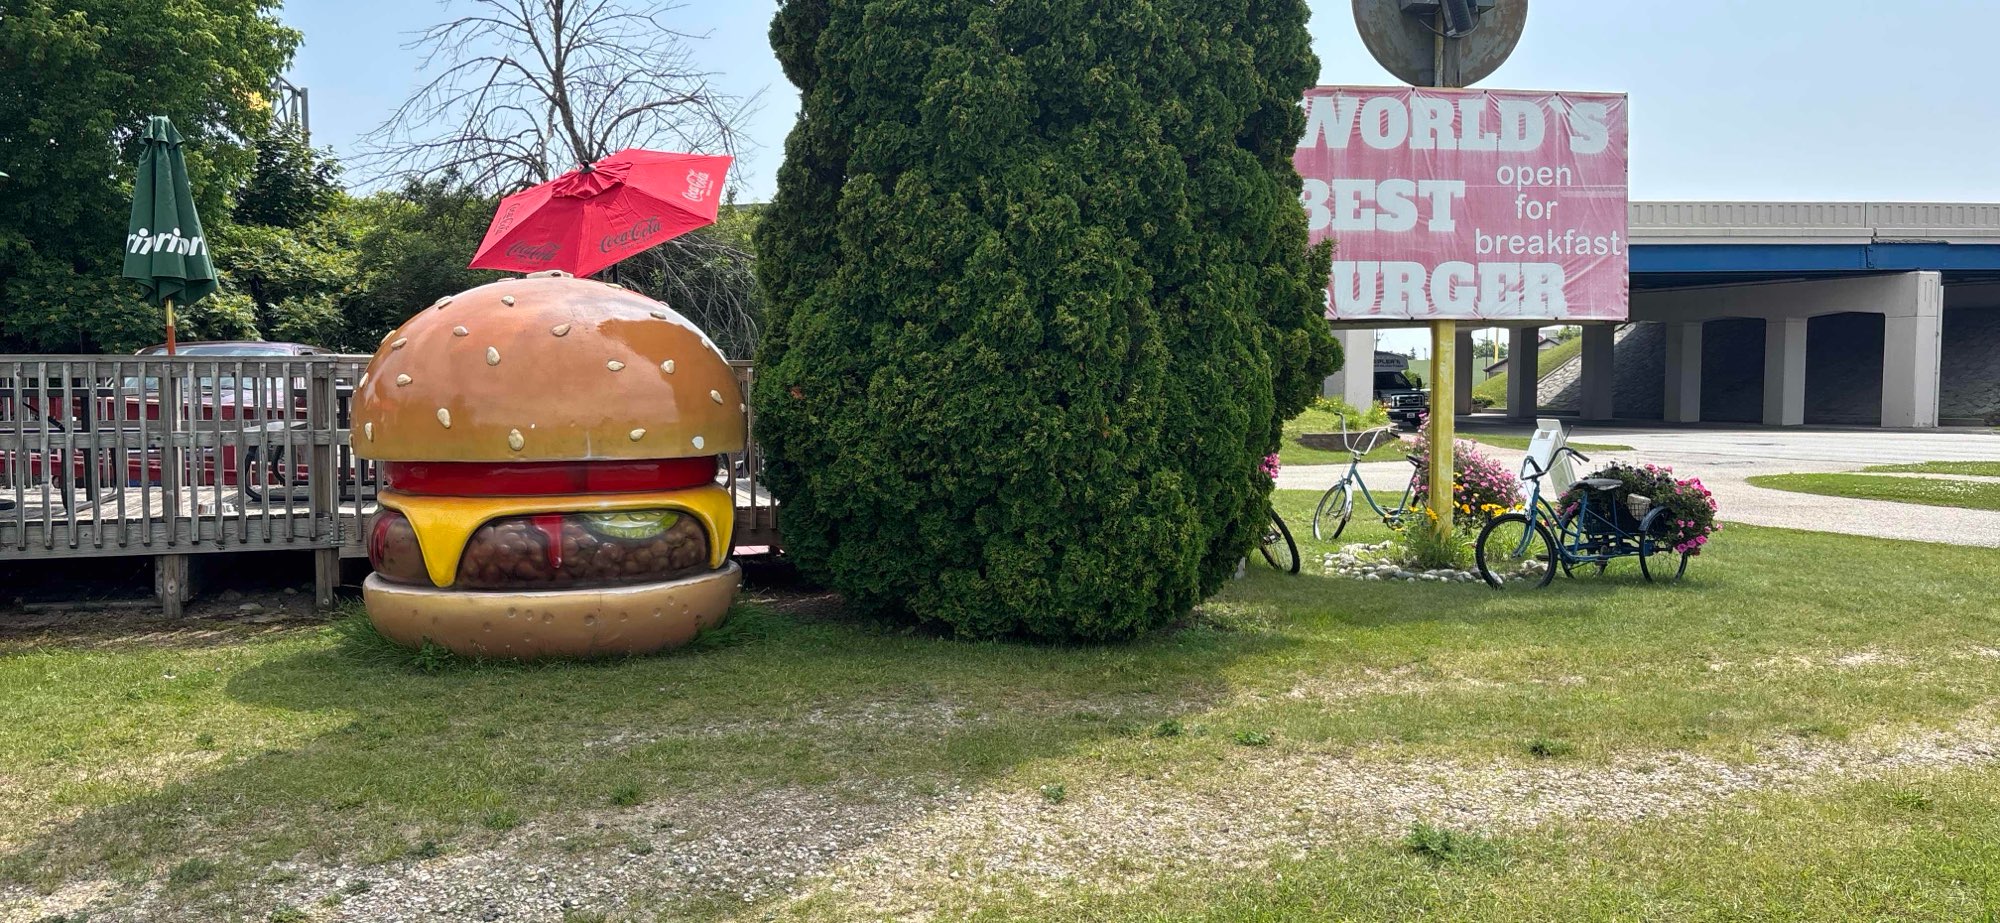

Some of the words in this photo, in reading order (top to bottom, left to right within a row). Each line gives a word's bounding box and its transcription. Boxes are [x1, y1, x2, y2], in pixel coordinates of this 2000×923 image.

[1297, 95, 1609, 154] WORLD'S
[1496, 165, 1571, 191] open
[1302, 178, 1466, 232] BEST
[1514, 193, 1559, 220] for
[1474, 228, 1622, 256] breakfast
[1324, 261, 1568, 317] URGER
